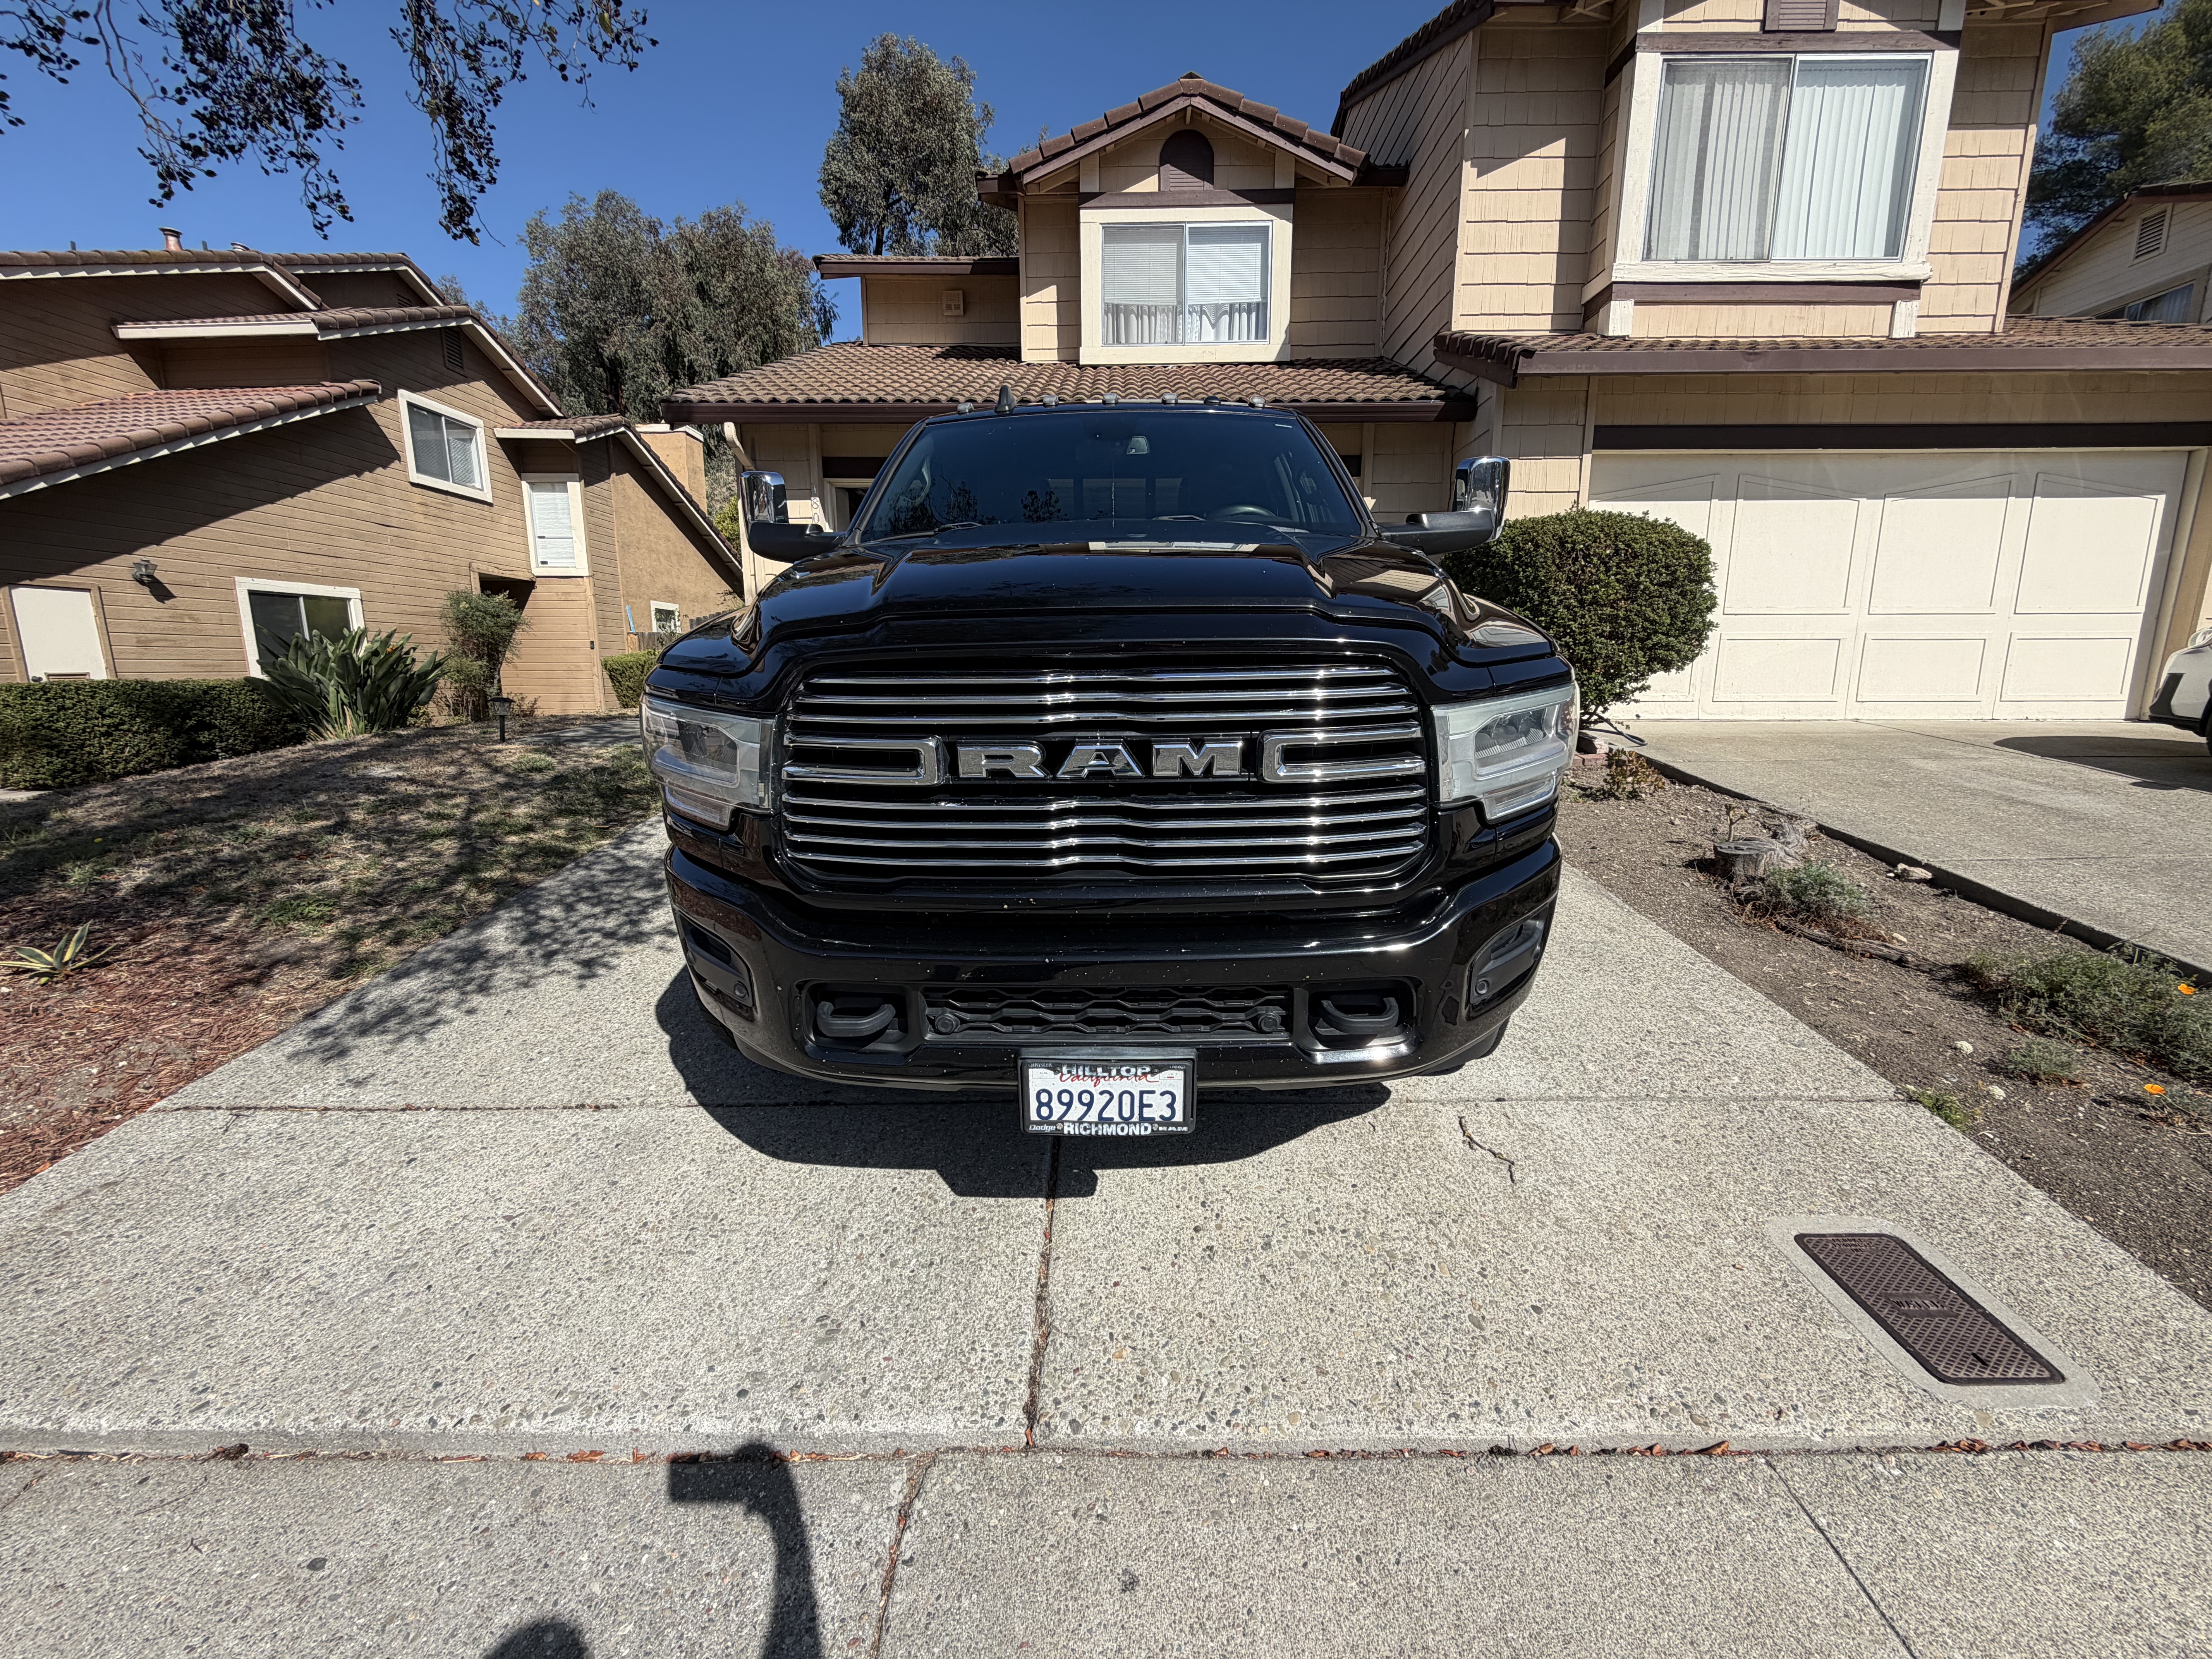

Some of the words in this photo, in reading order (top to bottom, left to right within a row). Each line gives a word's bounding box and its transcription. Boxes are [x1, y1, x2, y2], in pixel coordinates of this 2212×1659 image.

[957, 738, 1242, 778] RAM
[1062, 1064, 1151, 1076] HILLTOP
[1036, 1089, 1176, 1121] 89920E3
[1029, 1124, 1056, 1132] Dodge
[1063, 1122, 1152, 1135] RICHMOND
